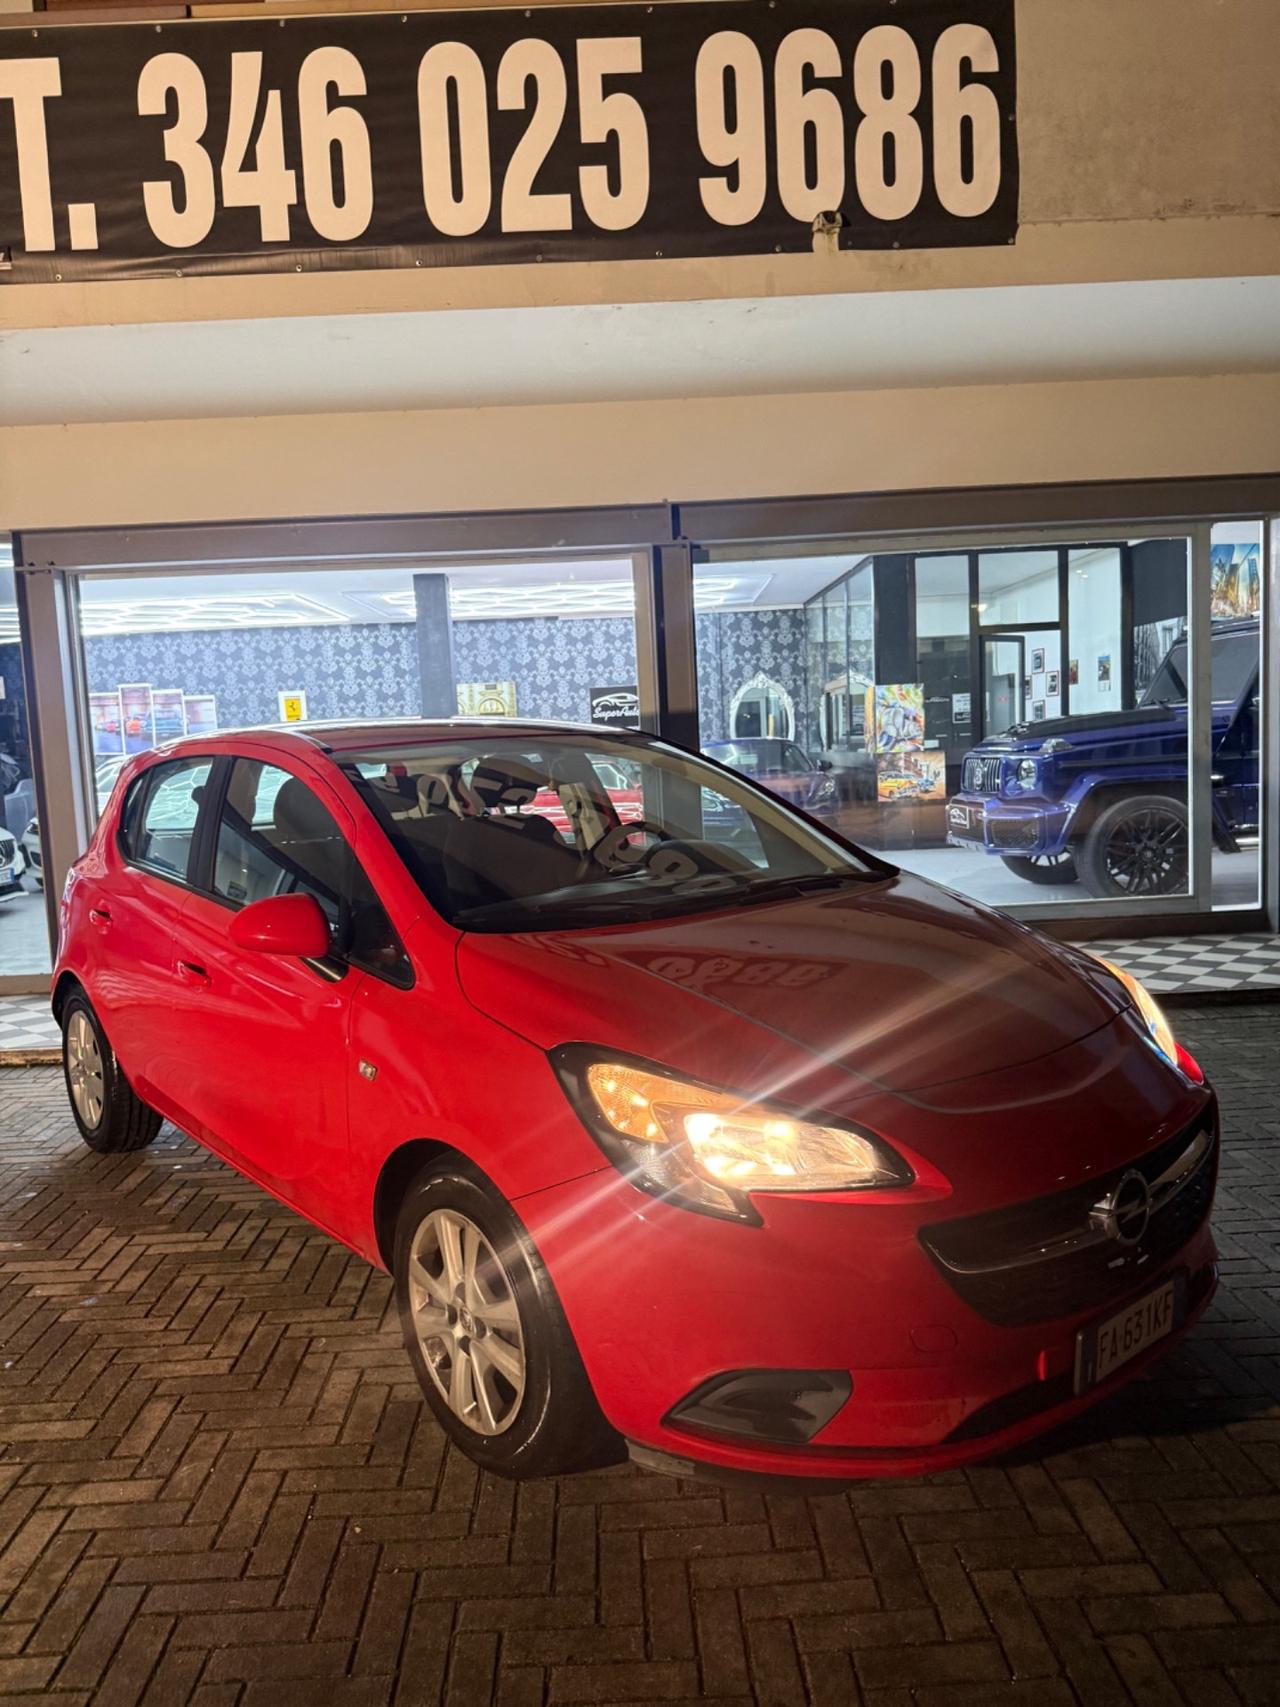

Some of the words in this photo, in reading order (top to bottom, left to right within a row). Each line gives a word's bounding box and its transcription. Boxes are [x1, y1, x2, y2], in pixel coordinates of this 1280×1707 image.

[0, 57, 99, 252] T.
[137, 46, 374, 248] 346
[417, 36, 650, 237] 025
[695, 23, 1001, 226] 9686
